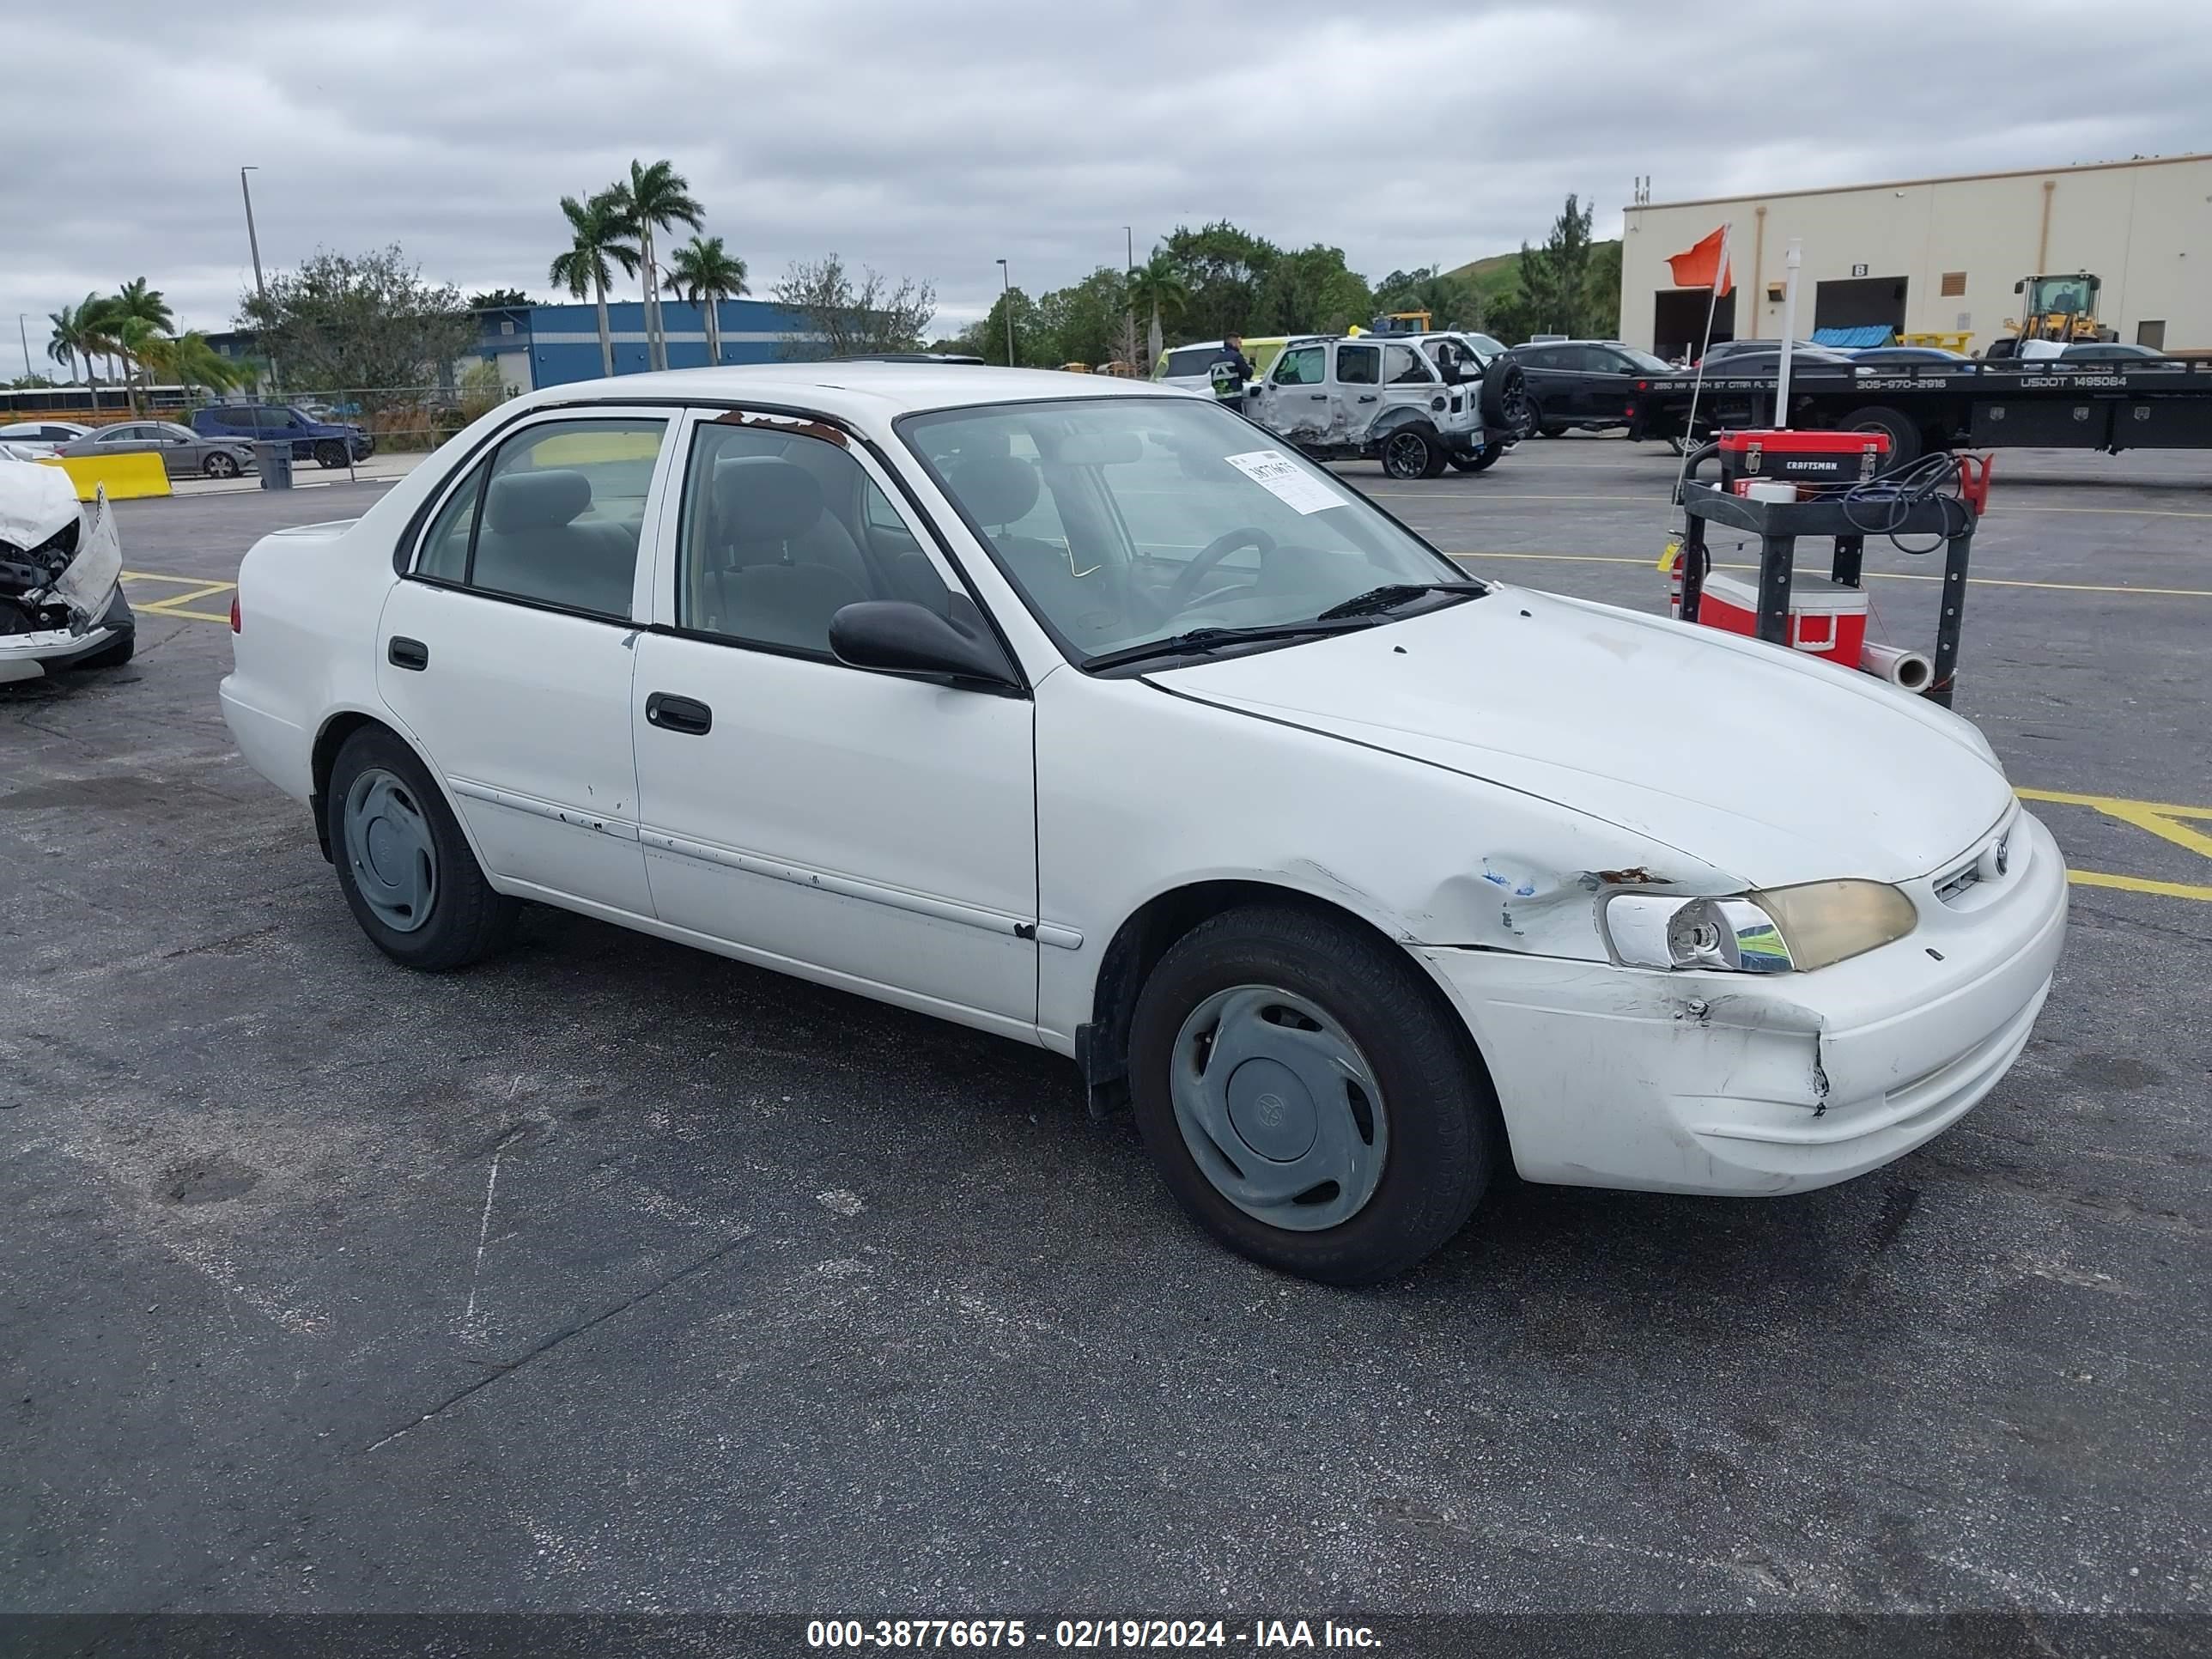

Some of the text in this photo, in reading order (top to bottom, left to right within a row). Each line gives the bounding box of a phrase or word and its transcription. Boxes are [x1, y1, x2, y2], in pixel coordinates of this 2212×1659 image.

[2021, 376, 2127, 387] USDOT 1495084
[1786, 461, 1838, 471] CRAFTSMAN
